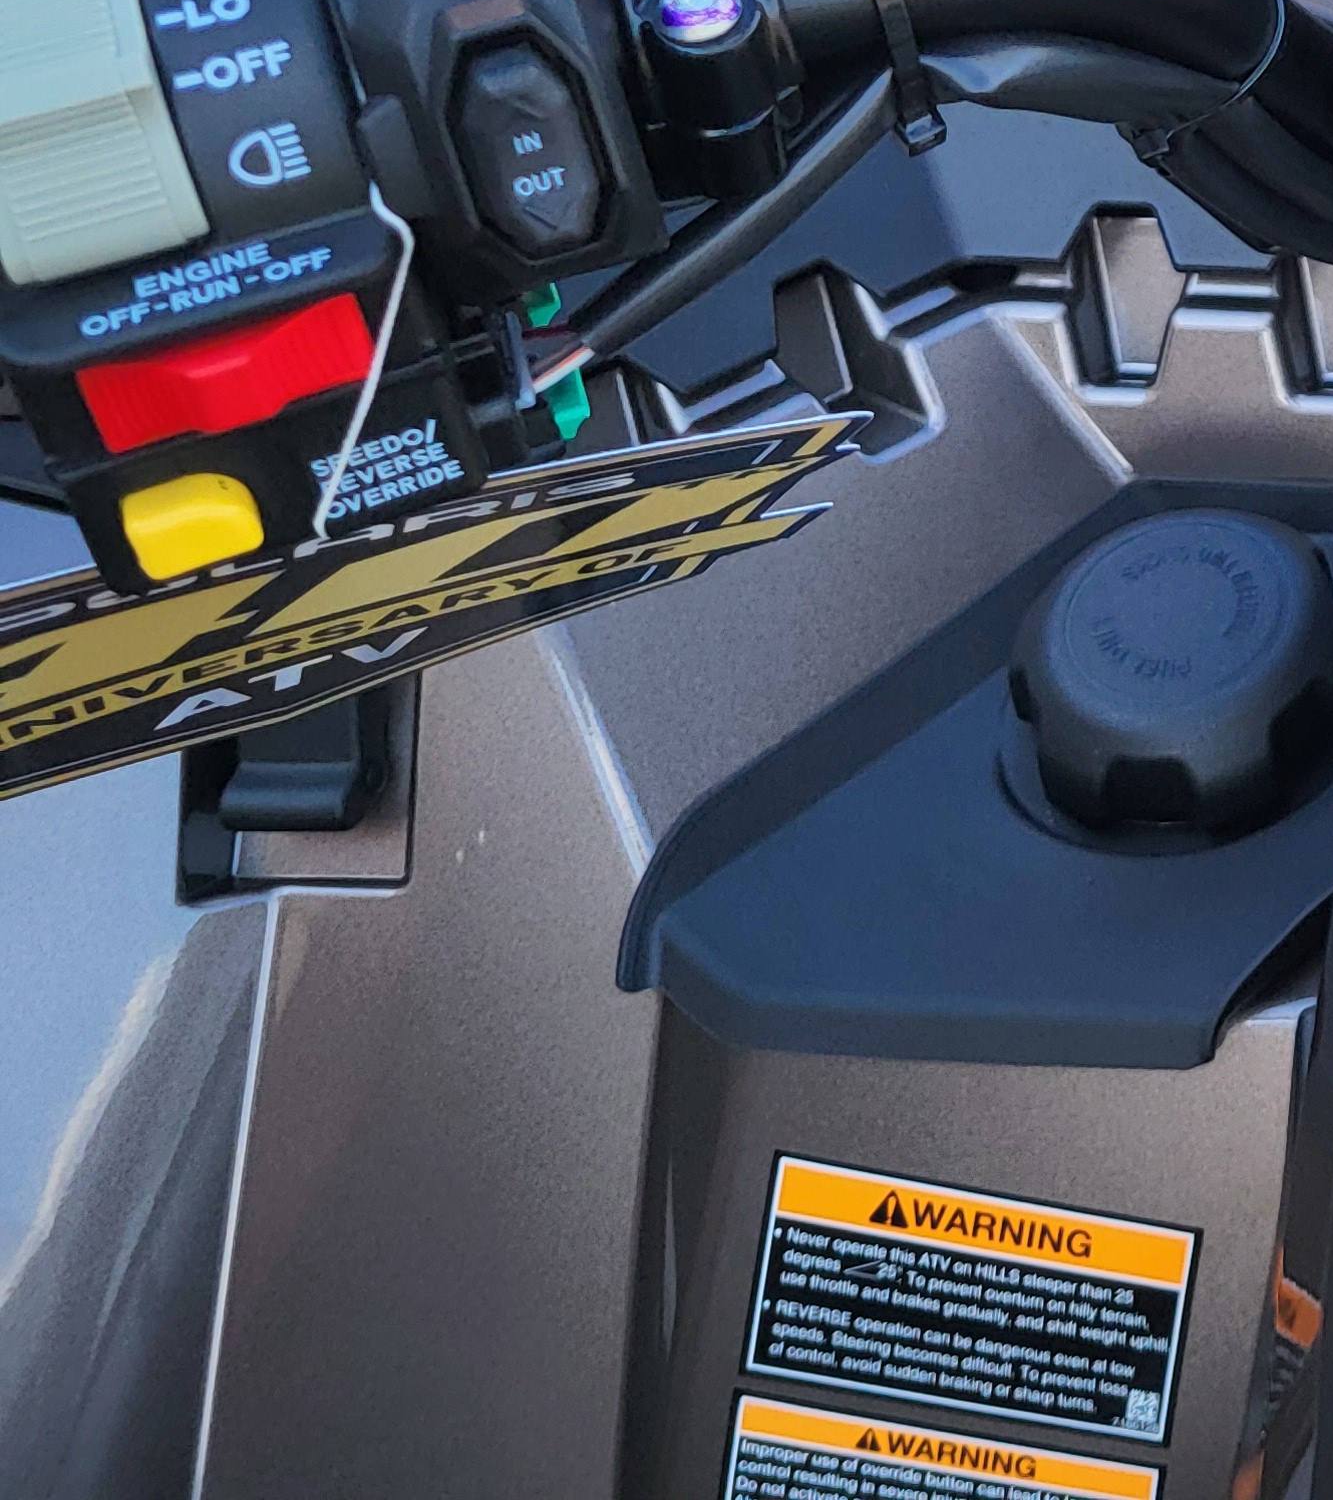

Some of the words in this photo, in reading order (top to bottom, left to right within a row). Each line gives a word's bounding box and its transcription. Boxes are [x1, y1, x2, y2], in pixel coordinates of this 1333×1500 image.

[513, 130, 543, 154] IN
[513, 167, 566, 196] OUT
[134, 242, 272, 299] ENGINE
[326, 460, 465, 519] OVERRIDE
[0, 569, 560, 740] NIVERSARY
[578, 539, 692, 574] OF
[153, 626, 429, 731] ATV
[913, 1198, 1094, 1259] WARNING
[783, 1248, 841, 1274] degrees
[907, 1269, 926, 1289] To
[927, 1277, 983, 1299] prevent
[984, 1287, 1044, 1311] overturn
[1046, 1299, 1066, 1315] on
[1068, 1300, 1098, 1323] hilly
[786, 1226, 831, 1249] Never
[832, 1238, 888, 1260] operate
[889, 1246, 916, 1265] this
[917, 1252, 951, 1272] ATV
[952, 1261, 973, 1279] on
[974, 1261, 1020, 1284] HILLS
[1079, 1280, 1112, 1301] than
[1112, 1288, 1134, 1307] 25
[775, 1298, 852, 1329] REVERSE
[853, 1315, 921, 1342] operation
[922, 1328, 951, 1345] can
[952, 1332, 973, 1350] be
[974, 1336, 1051, 1366] dangerous
[1053, 1352, 1089, 1371] even
[1109, 1360, 1136, 1380] low
[780, 1270, 807, 1288] use
[808, 1273, 859, 1298] throttle
[860, 1284, 890, 1302] and
[892, 1288, 941, 1313] brakes
[1014, 1314, 1044, 1332] and
[1045, 1318, 1077, 1338] shift
[1079, 1324, 1127, 1348] weight
[768, 1341, 784, 1359] of
[841, 1355, 882, 1374] avoid
[883, 1363, 937, 1387] sudden
[938, 1371, 993, 1399] braking
[994, 1383, 1012, 1400] or
[1013, 1386, 1055, 1409] sharp
[830, 1329, 891, 1359] Steering
[893, 1342, 959, 1370] becomes
[1020, 1364, 1040, 1383] To
[1041, 1370, 1096, 1393] prevent
[1098, 1378, 1128, 1397] loss
[738, 1460, 791, 1480] control
[793, 1469, 858, 1495] resulting
[860, 1479, 876, 1495] in
[740, 1439, 809, 1464] Improper
[811, 1454, 839, 1470] use
[841, 1457, 859, 1473] of
[861, 1462, 922, 1484] override
[925, 1471, 974, 1493] button
[976, 1483, 1005, 1499] can
[887, 1430, 1037, 1478] WARNING
[735, 1475, 758, 1493] Do
[760, 1482, 786, 1498] not
